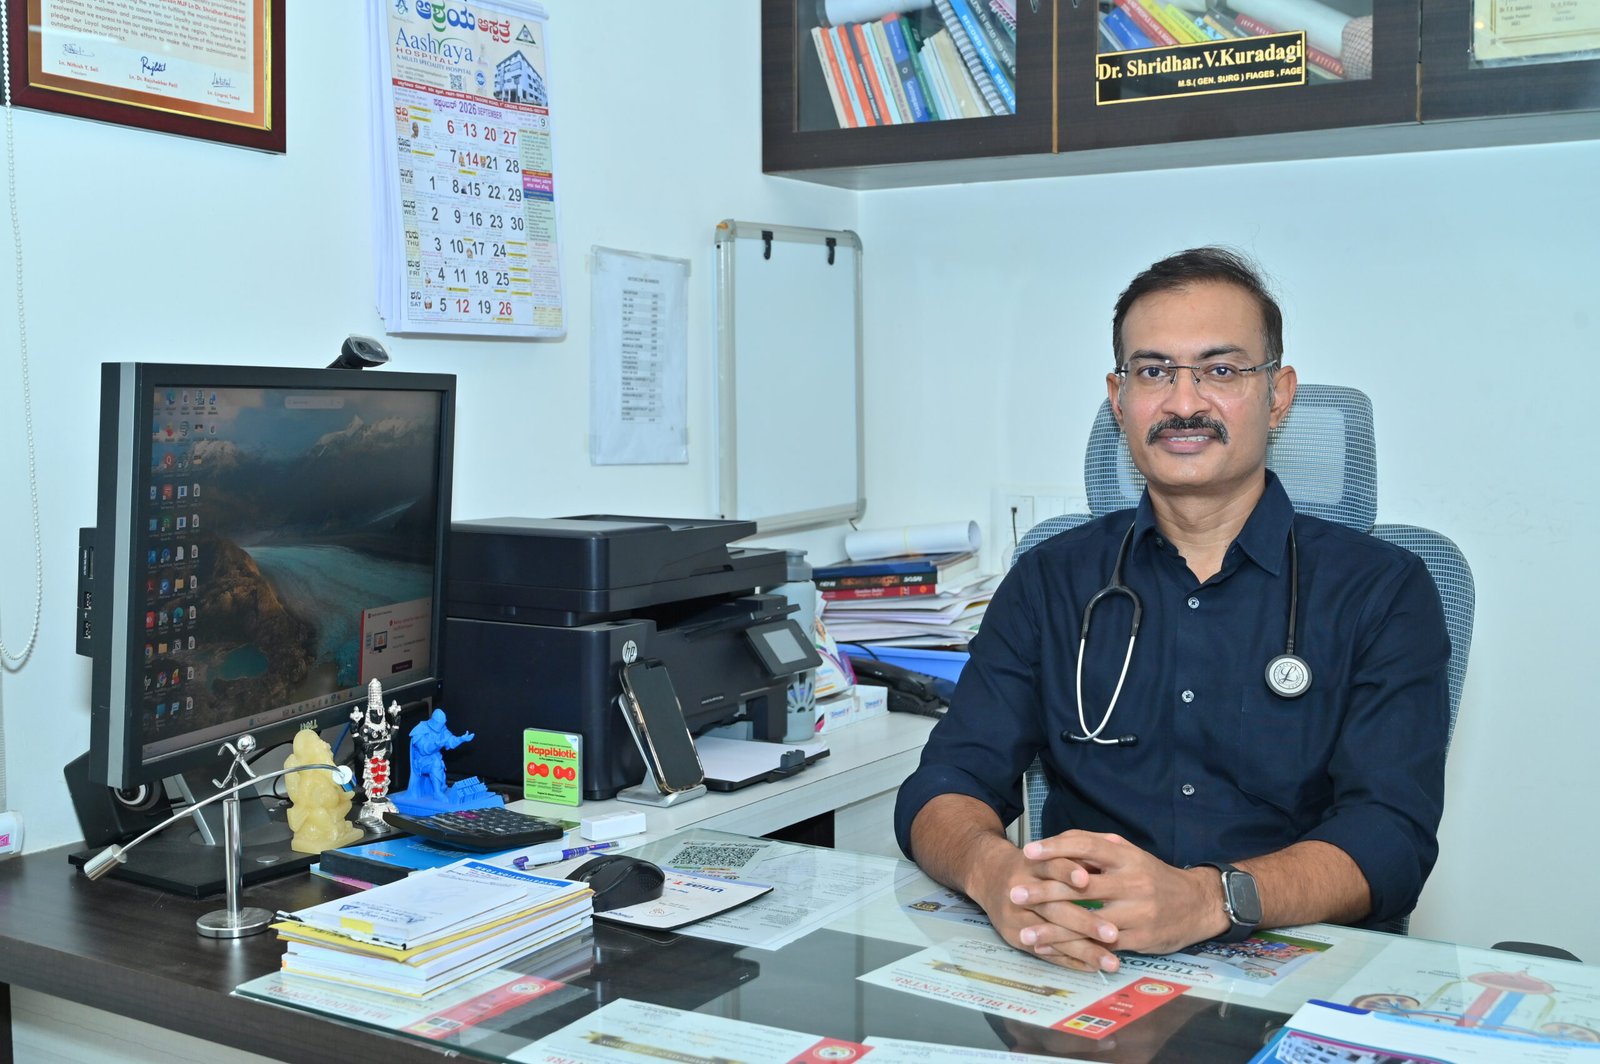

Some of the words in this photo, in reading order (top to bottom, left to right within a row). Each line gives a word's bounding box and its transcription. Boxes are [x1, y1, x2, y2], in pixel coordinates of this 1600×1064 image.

[50, 4, 73, 13] resolved
[50, 12, 70, 20] pledge
[85, 19, 99, 27] Loyal
[50, 21, 82, 32] outstanding
[396, 26, 473, 64] Aashraya
[962, 14, 982, 47] RECORD
[980, 47, 996, 71] BOOK
[396, 47, 453, 65] HOSPITAL
[1098, 62, 1123, 81] Dr.
[1126, 40, 1303, 78] Shridhar.V.Kuradagi
[419, 58, 446, 71] SPECIALITY
[446, 65, 472, 75] HOSPITAL
[1197, 76, 1216, 86] GEN.
[1217, 73, 1240, 84] SURG
[1246, 70, 1275, 80] FIAGES
[459, 102, 477, 115] 2026
[478, 107, 503, 119] SEPTEMBER
[541, 118, 545, 127] 9
[447, 120, 454, 134] 6
[464, 123, 477, 138] 13
[484, 126, 497, 142] 20
[504, 130, 517, 145] 27
[450, 150, 457, 163] 7
[466, 152, 479, 166] 14
[486, 155, 498, 170] 21
[506, 159, 519, 174] 28
[429, 176, 435, 190] 1
[452, 179, 459, 193] 8
[468, 182, 481, 197] 15
[488, 185, 501, 200] 22
[508, 187, 522, 202] 29
[432, 207, 439, 221] 2
[454, 210, 461, 223] 9
[470, 212, 483, 227] 16
[490, 215, 503, 229] 23
[511, 217, 524, 231] 30
[435, 237, 442, 252] 3
[451, 239, 464, 253] 10
[472, 241, 485, 256] 17
[493, 244, 506, 257] 24
[438, 267, 445, 281] 4
[454, 268, 466, 283] 11
[476, 270, 488, 285] 18
[496, 272, 510, 286] 25
[440, 298, 447, 312] 5
[456, 299, 469, 313] 12
[478, 300, 491, 314] 19
[499, 302, 512, 316] 26
[528, 745, 576, 758] Happibiotic
[475, 866, 497, 874] FORM
[498, 872, 560, 886] INVESTIGATION
[891, 976, 949, 996] CENTRE
[950, 990, 1004, 1008] BLOOD
[1006, 1004, 1038, 1015] IMA
